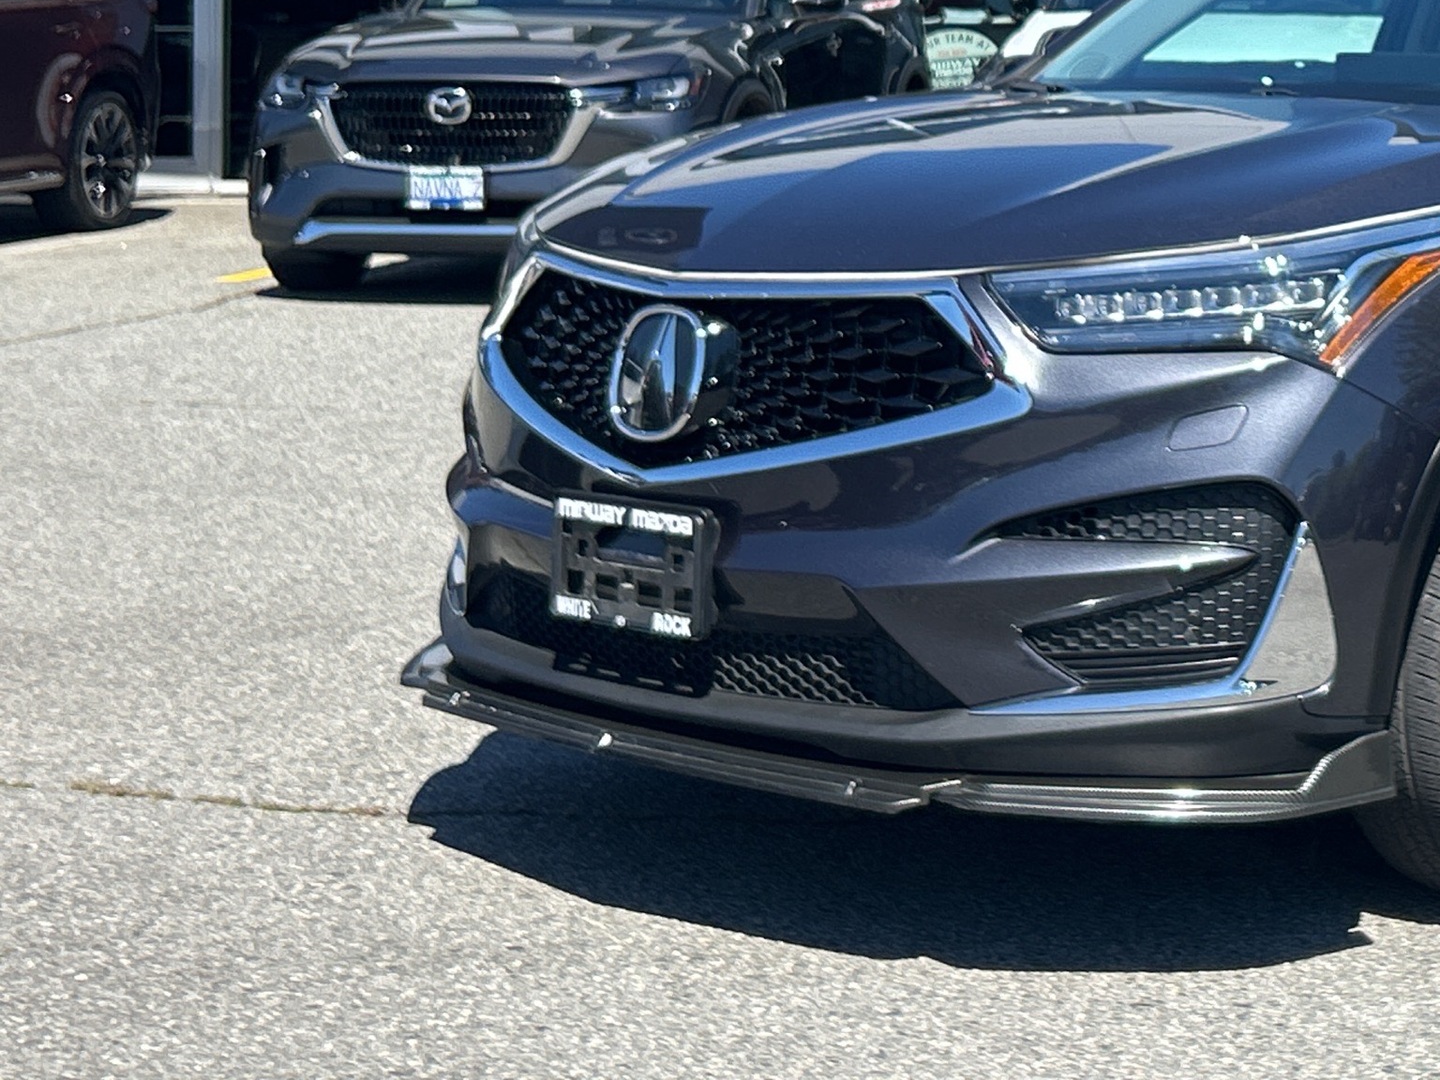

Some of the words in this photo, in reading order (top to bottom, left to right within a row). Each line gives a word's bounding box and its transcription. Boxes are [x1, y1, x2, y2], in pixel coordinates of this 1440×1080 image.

[945, 33, 974, 45] TEAM
[554, 594, 593, 620] WHITE
[651, 611, 693, 638] ROCK
